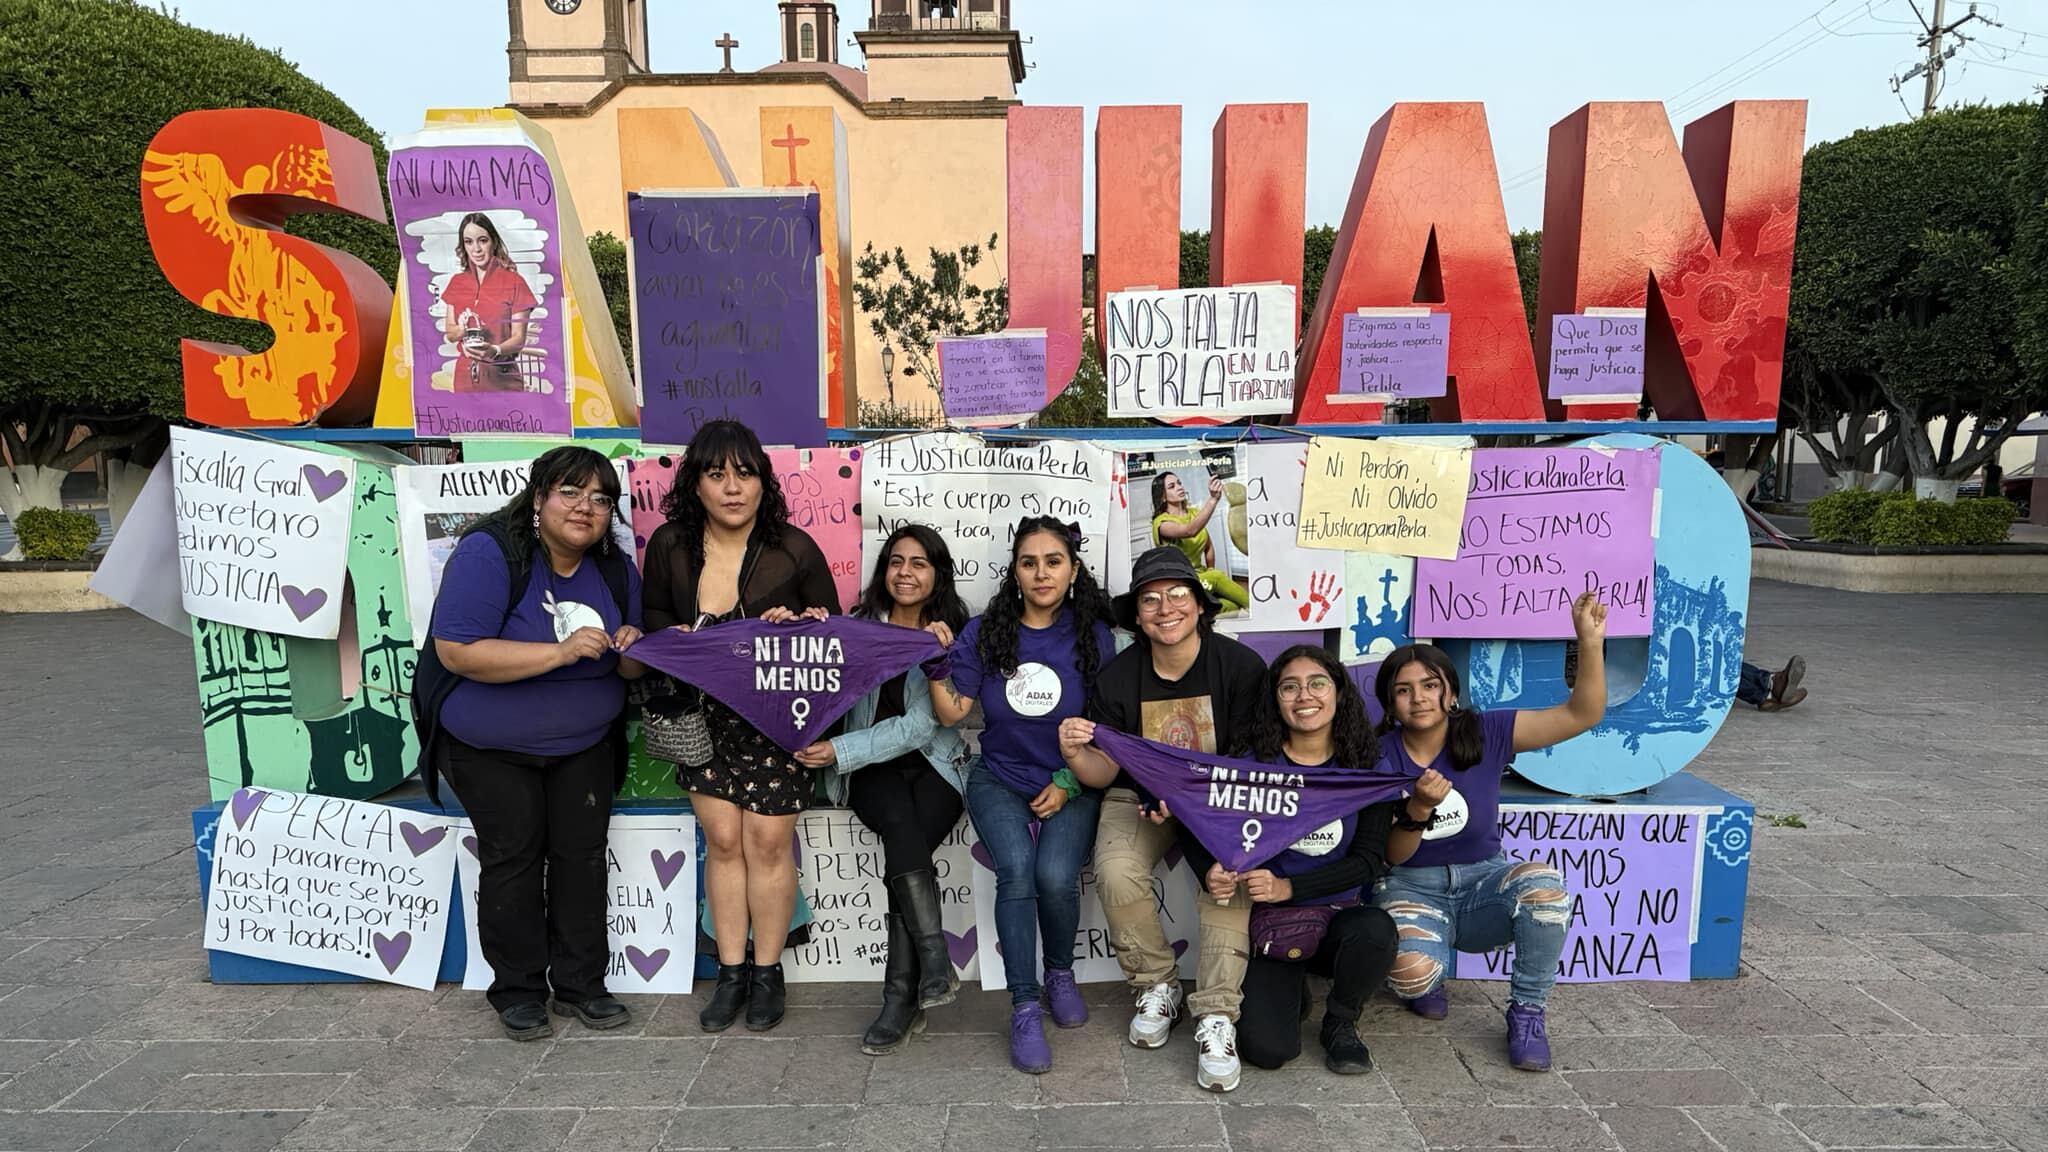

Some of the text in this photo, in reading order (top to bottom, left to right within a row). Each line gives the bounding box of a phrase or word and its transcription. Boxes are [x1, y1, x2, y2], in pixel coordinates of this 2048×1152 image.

[395, 152, 552, 206] NI UNA MÁS
[938, 98, 1808, 428] JUAN
[1109, 292, 1258, 350] NOS FALTA
[1348, 318, 1431, 338] Exigimos a las
[1558, 319, 1638, 344] Que Dios
[1345, 334, 1442, 349] autoridades respuesta
[1555, 342, 1643, 362] permita que se
[1228, 351, 1289, 375] EN LA
[1346, 357, 1353, 368] y
[1554, 364, 1579, 381] haga
[1110, 352, 1225, 410] PERLA
[1229, 378, 1295, 402] TARIMA
[1326, 451, 1345, 477] Ni
[440, 467, 528, 497] ALCEMOS
[1351, 483, 1437, 509] Ni Olvido
[944, 489, 1011, 518] cuerpo
[1021, 494, 1041, 513] es
[1500, 511, 1612, 545] ESTAMOS
[1462, 552, 1566, 577] TODAS.
[181, 555, 281, 604] JUSTICIA
[755, 637, 780, 661] NI
[791, 637, 845, 664] UNA
[755, 667, 841, 692] MENOS
[1026, 692, 1053, 700] ADAX
[1208, 782, 1299, 817] MENOS
[251, 790, 393, 853] PERLA
[804, 817, 833, 849] El
[1641, 813, 1690, 843] QUE
[225, 832, 425, 887] no pararemos
[218, 856, 288, 895] hasta
[298, 876, 342, 902] que
[387, 885, 439, 920] haga
[617, 885, 654, 909] ELLA
[1604, 890, 1621, 926] Y
[1637, 887, 1679, 926] NO
[403, 911, 428, 932] ti
[216, 916, 230, 943] y
[283, 920, 372, 959] todas!!
